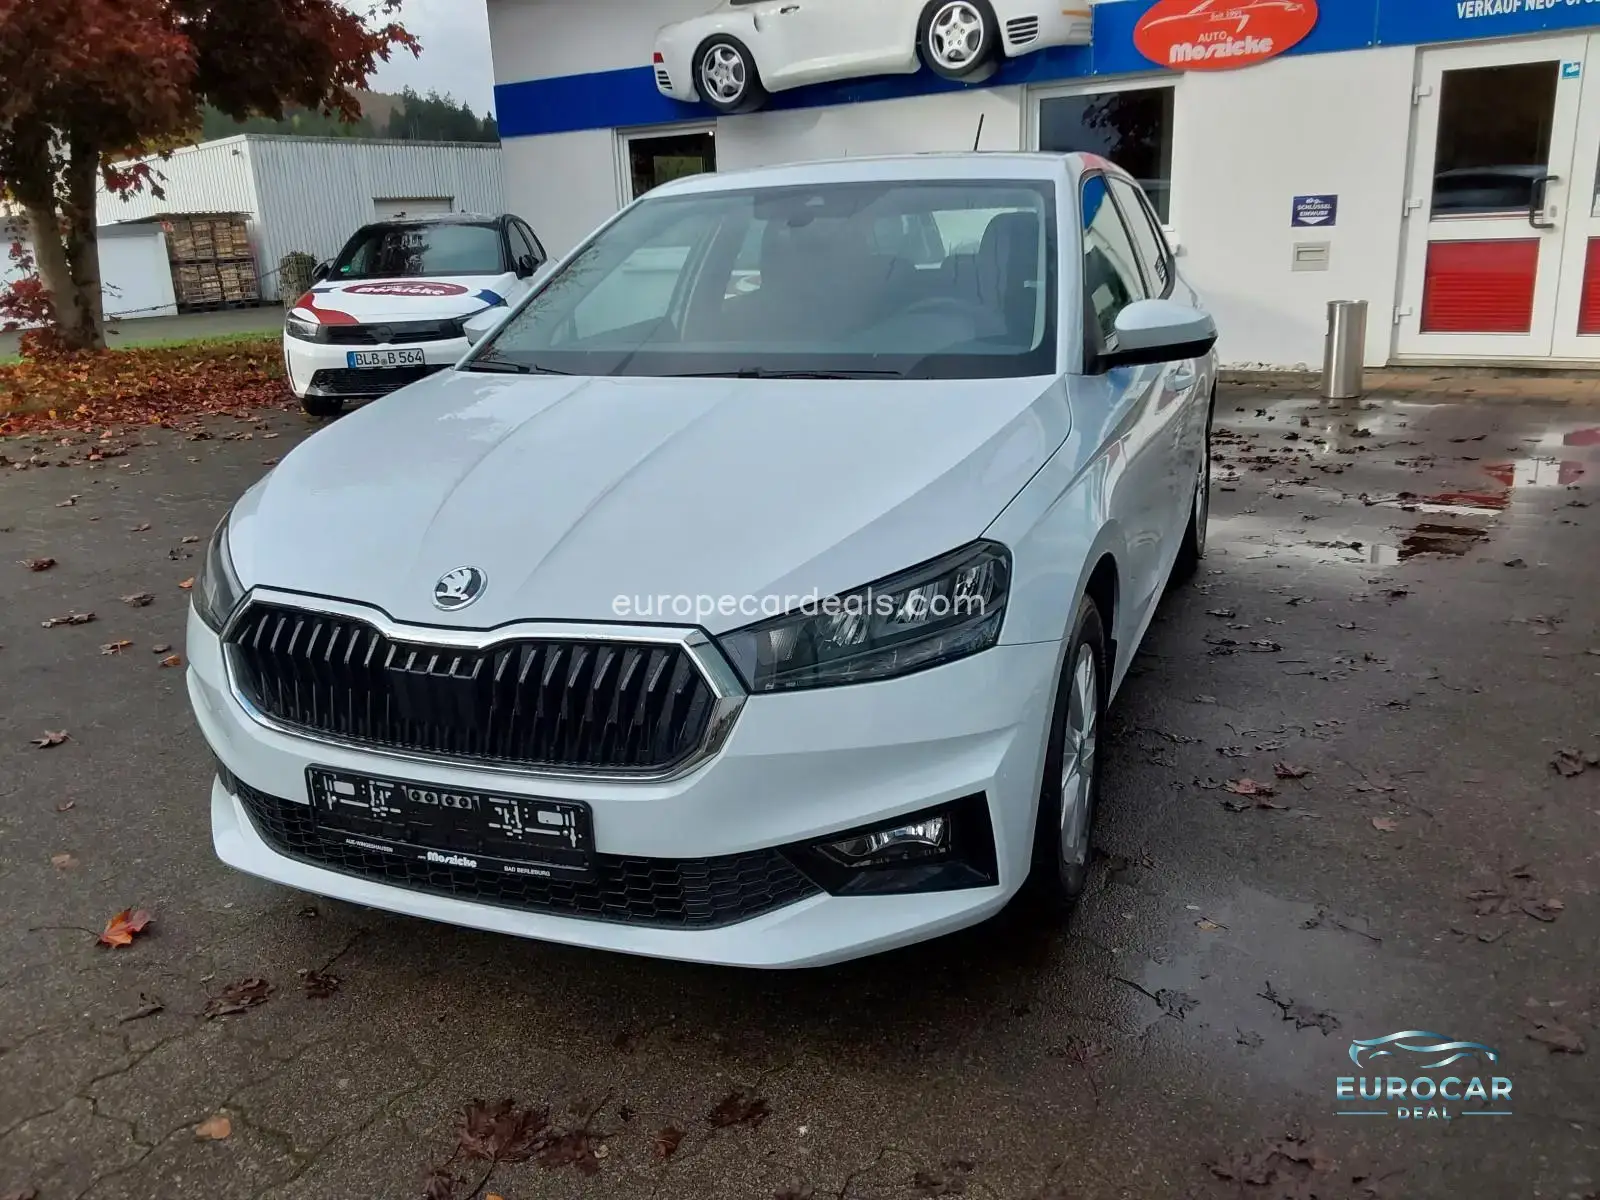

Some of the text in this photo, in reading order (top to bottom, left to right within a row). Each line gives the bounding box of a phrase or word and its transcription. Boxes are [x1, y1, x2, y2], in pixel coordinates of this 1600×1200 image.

[1457, 0, 1521, 19] VERKAUF
[1197, 30, 1228, 42] AUTO
[355, 350, 423, 366] BLB B 564
